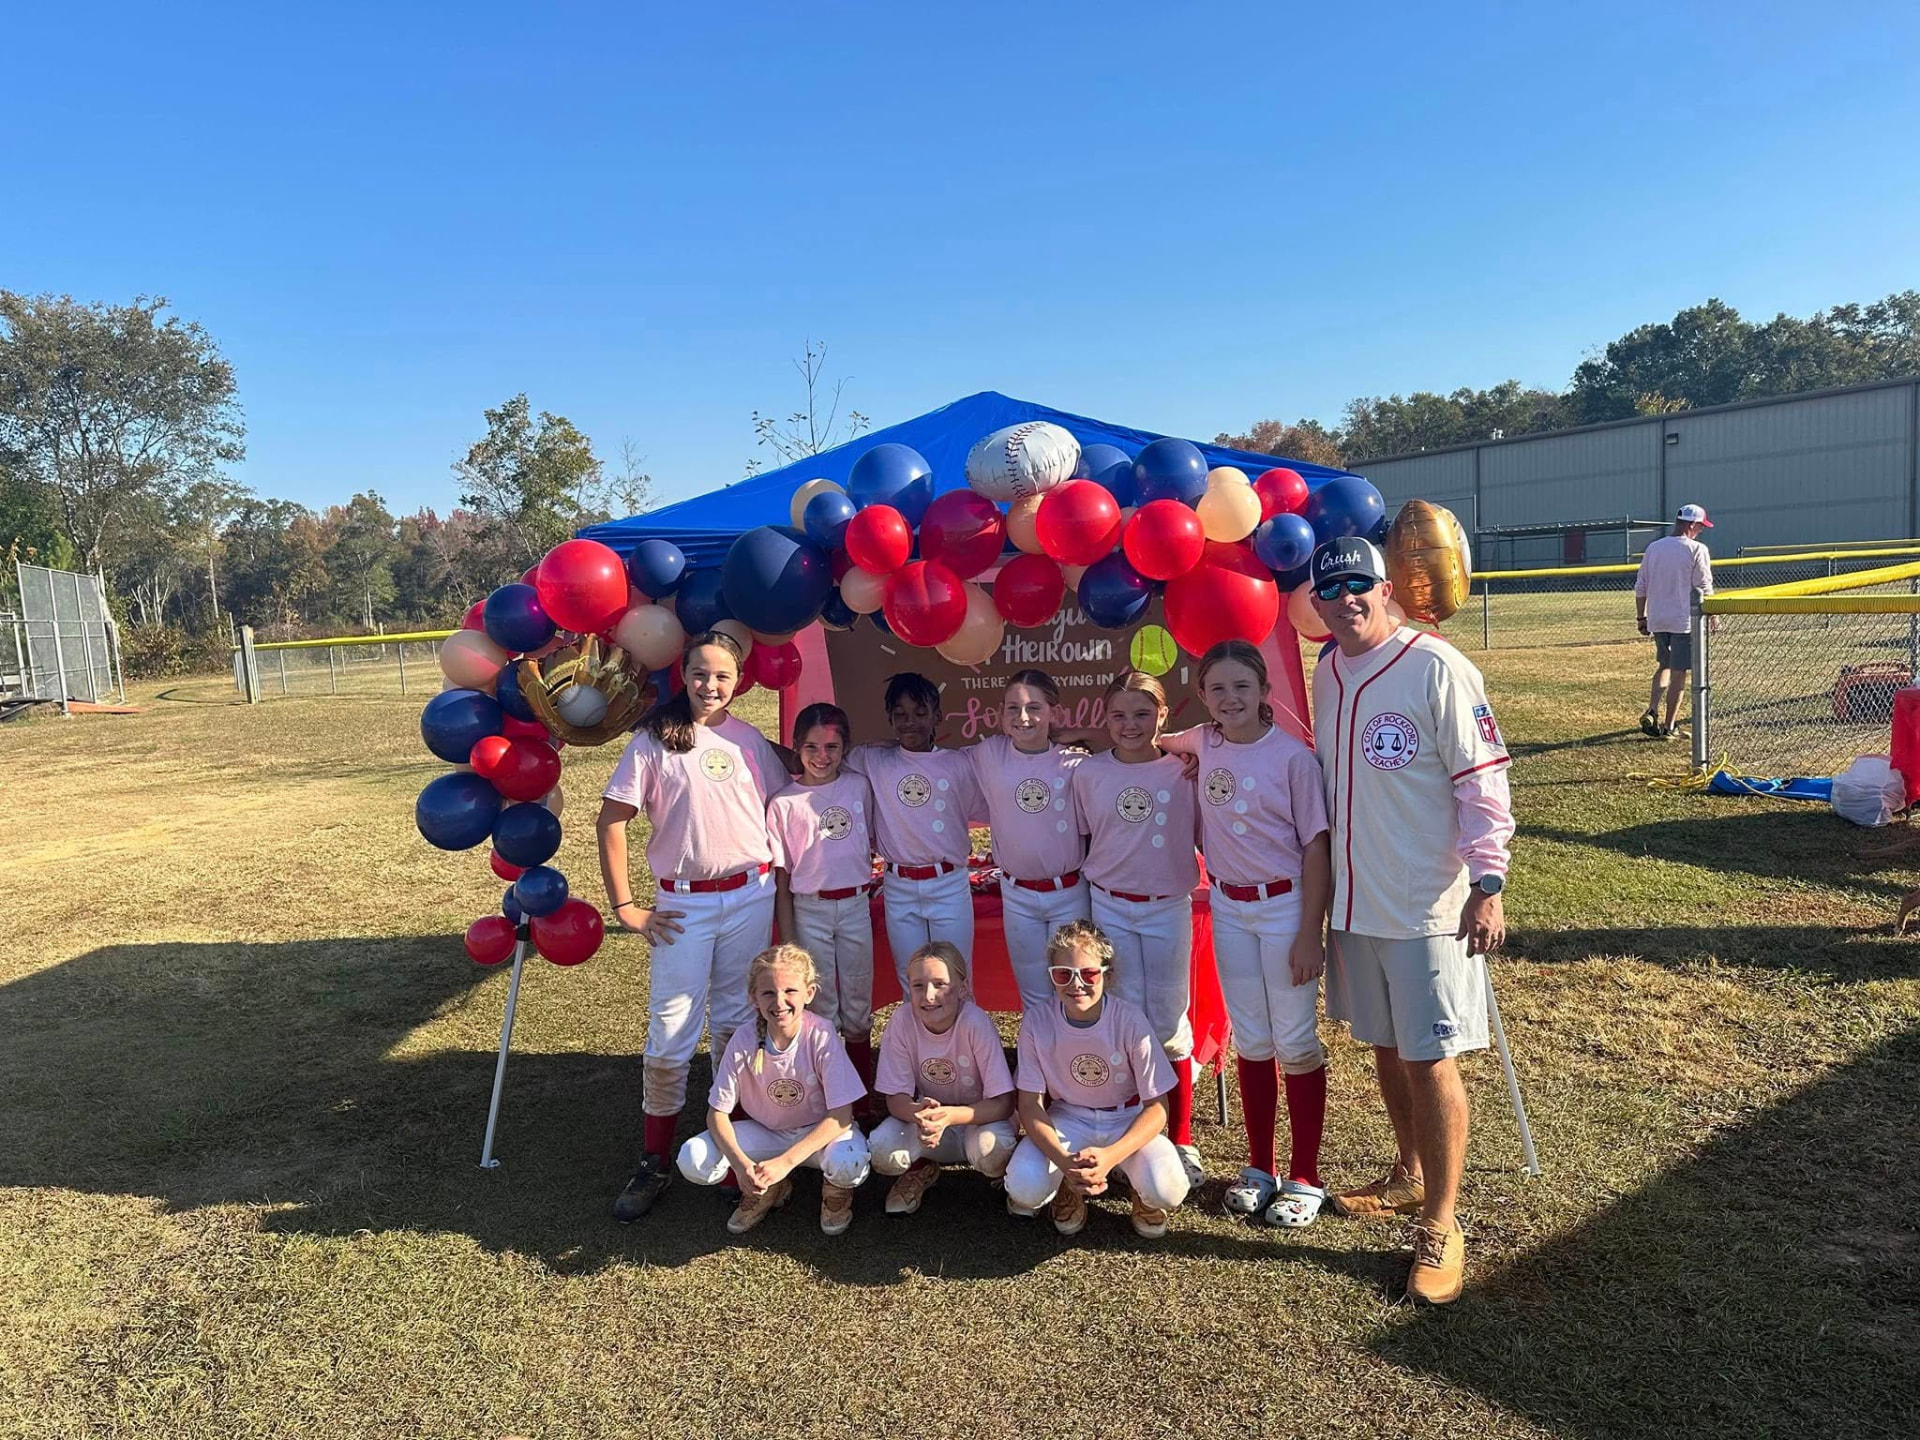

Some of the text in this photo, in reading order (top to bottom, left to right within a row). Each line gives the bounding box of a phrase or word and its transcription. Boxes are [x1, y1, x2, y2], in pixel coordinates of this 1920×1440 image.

[1320, 549, 1362, 570] Crush
[960, 672, 1114, 690] THERE' RYING IN
[1364, 715, 1416, 745] CITY OF ROCKFORD
[1370, 754, 1406, 768] PEACHES
